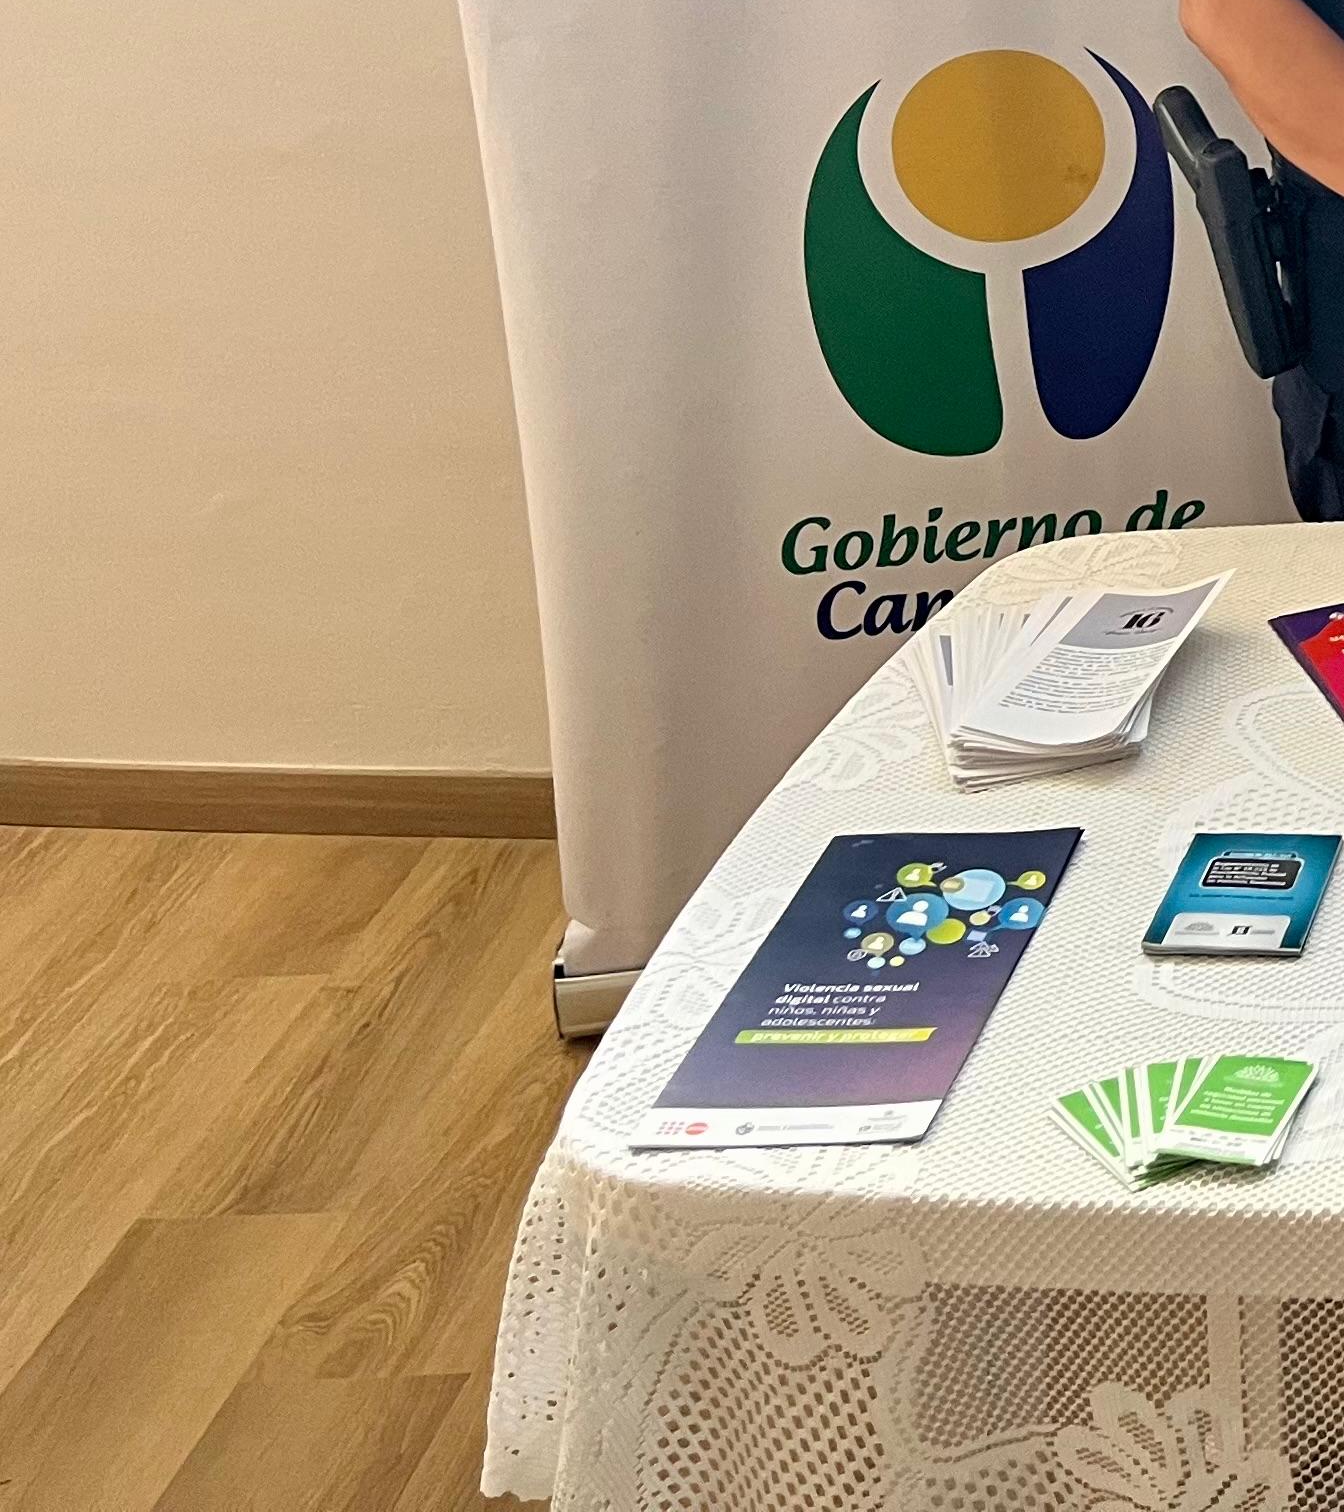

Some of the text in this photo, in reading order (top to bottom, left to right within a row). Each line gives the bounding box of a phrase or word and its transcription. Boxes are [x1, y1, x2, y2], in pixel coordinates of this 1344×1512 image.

[781, 489, 1206, 576] Gobierno de
[784, 981, 920, 993] Violencia sexual
[775, 994, 887, 1006] digital contra
[868, 1006, 881, 1017] y
